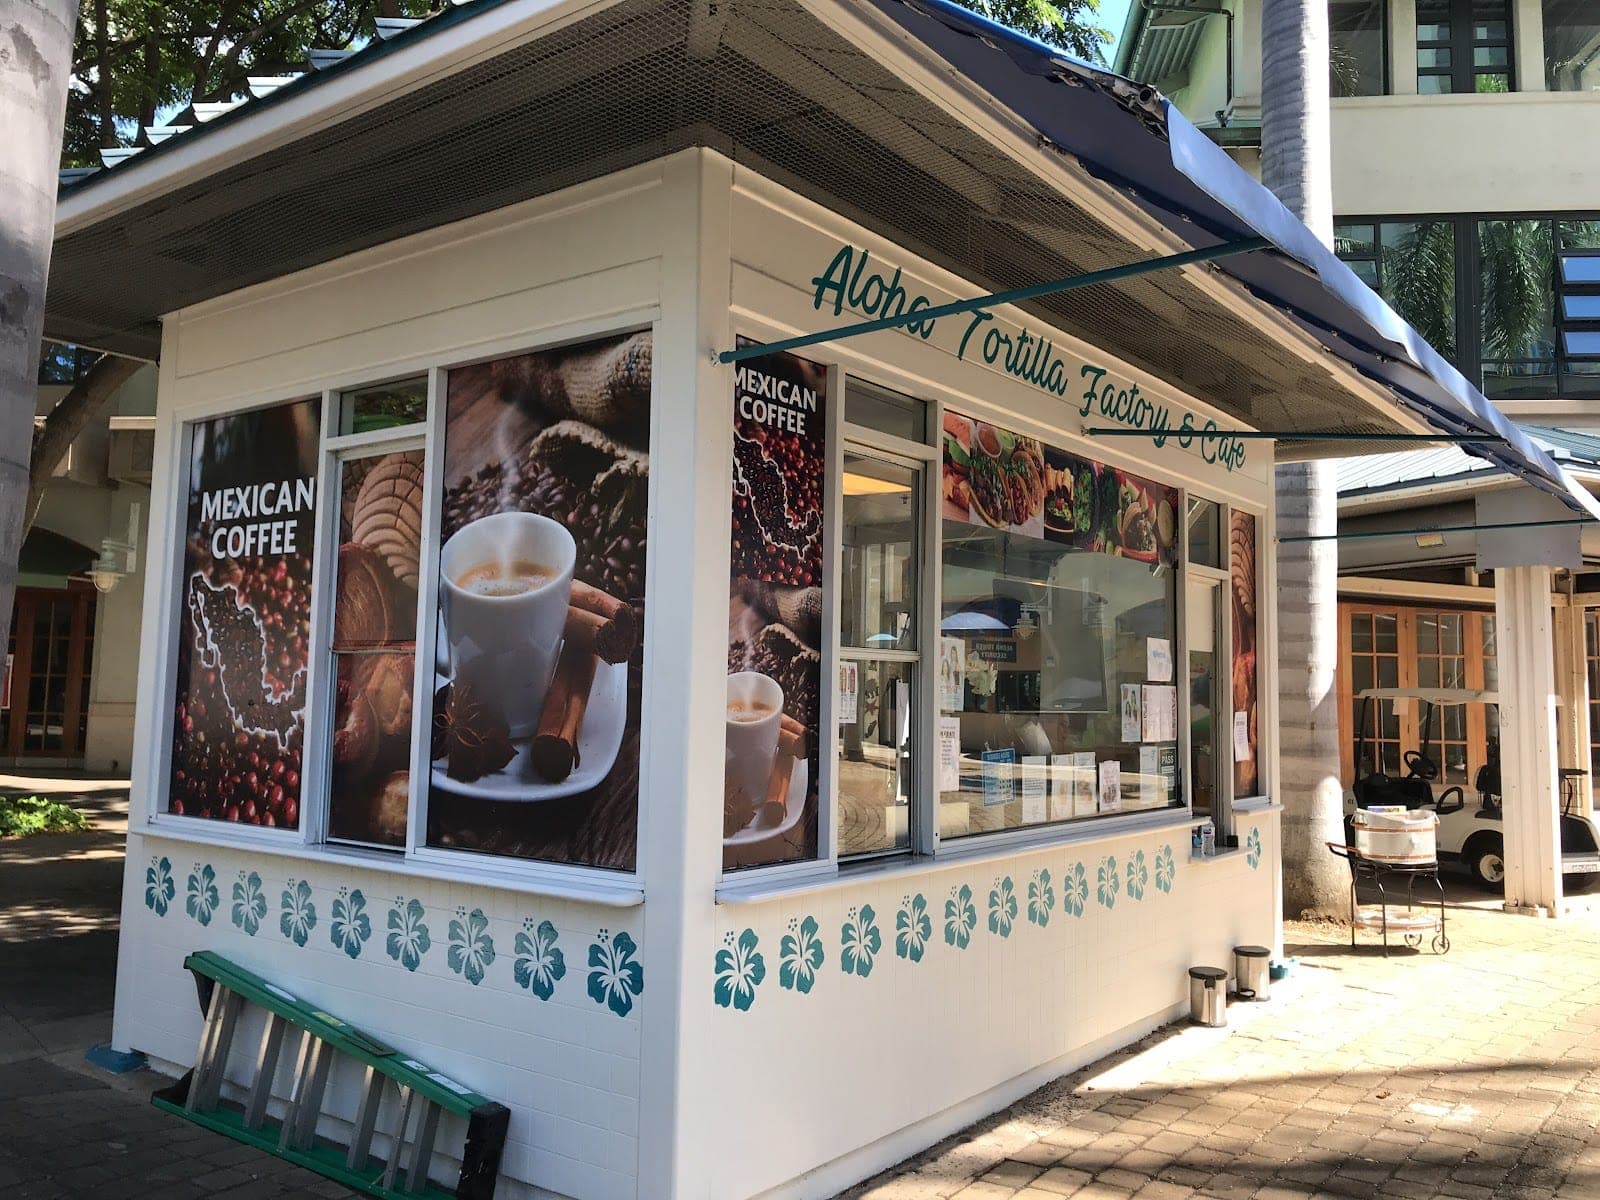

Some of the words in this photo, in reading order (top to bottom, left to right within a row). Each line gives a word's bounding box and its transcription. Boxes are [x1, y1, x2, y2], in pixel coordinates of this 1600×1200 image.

[812, 244, 936, 340] Aloha
[954, 300, 1069, 396] Tortilla
[1079, 364, 1171, 448] Factory
[1178, 412, 1195, 449] &
[735, 366, 817, 413] MEXICAN
[740, 395, 806, 436] COFFEE
[200, 476, 315, 523] MEXICAN
[211, 519, 298, 560] COFFEE
[1161, 754, 1174, 764] PASS
